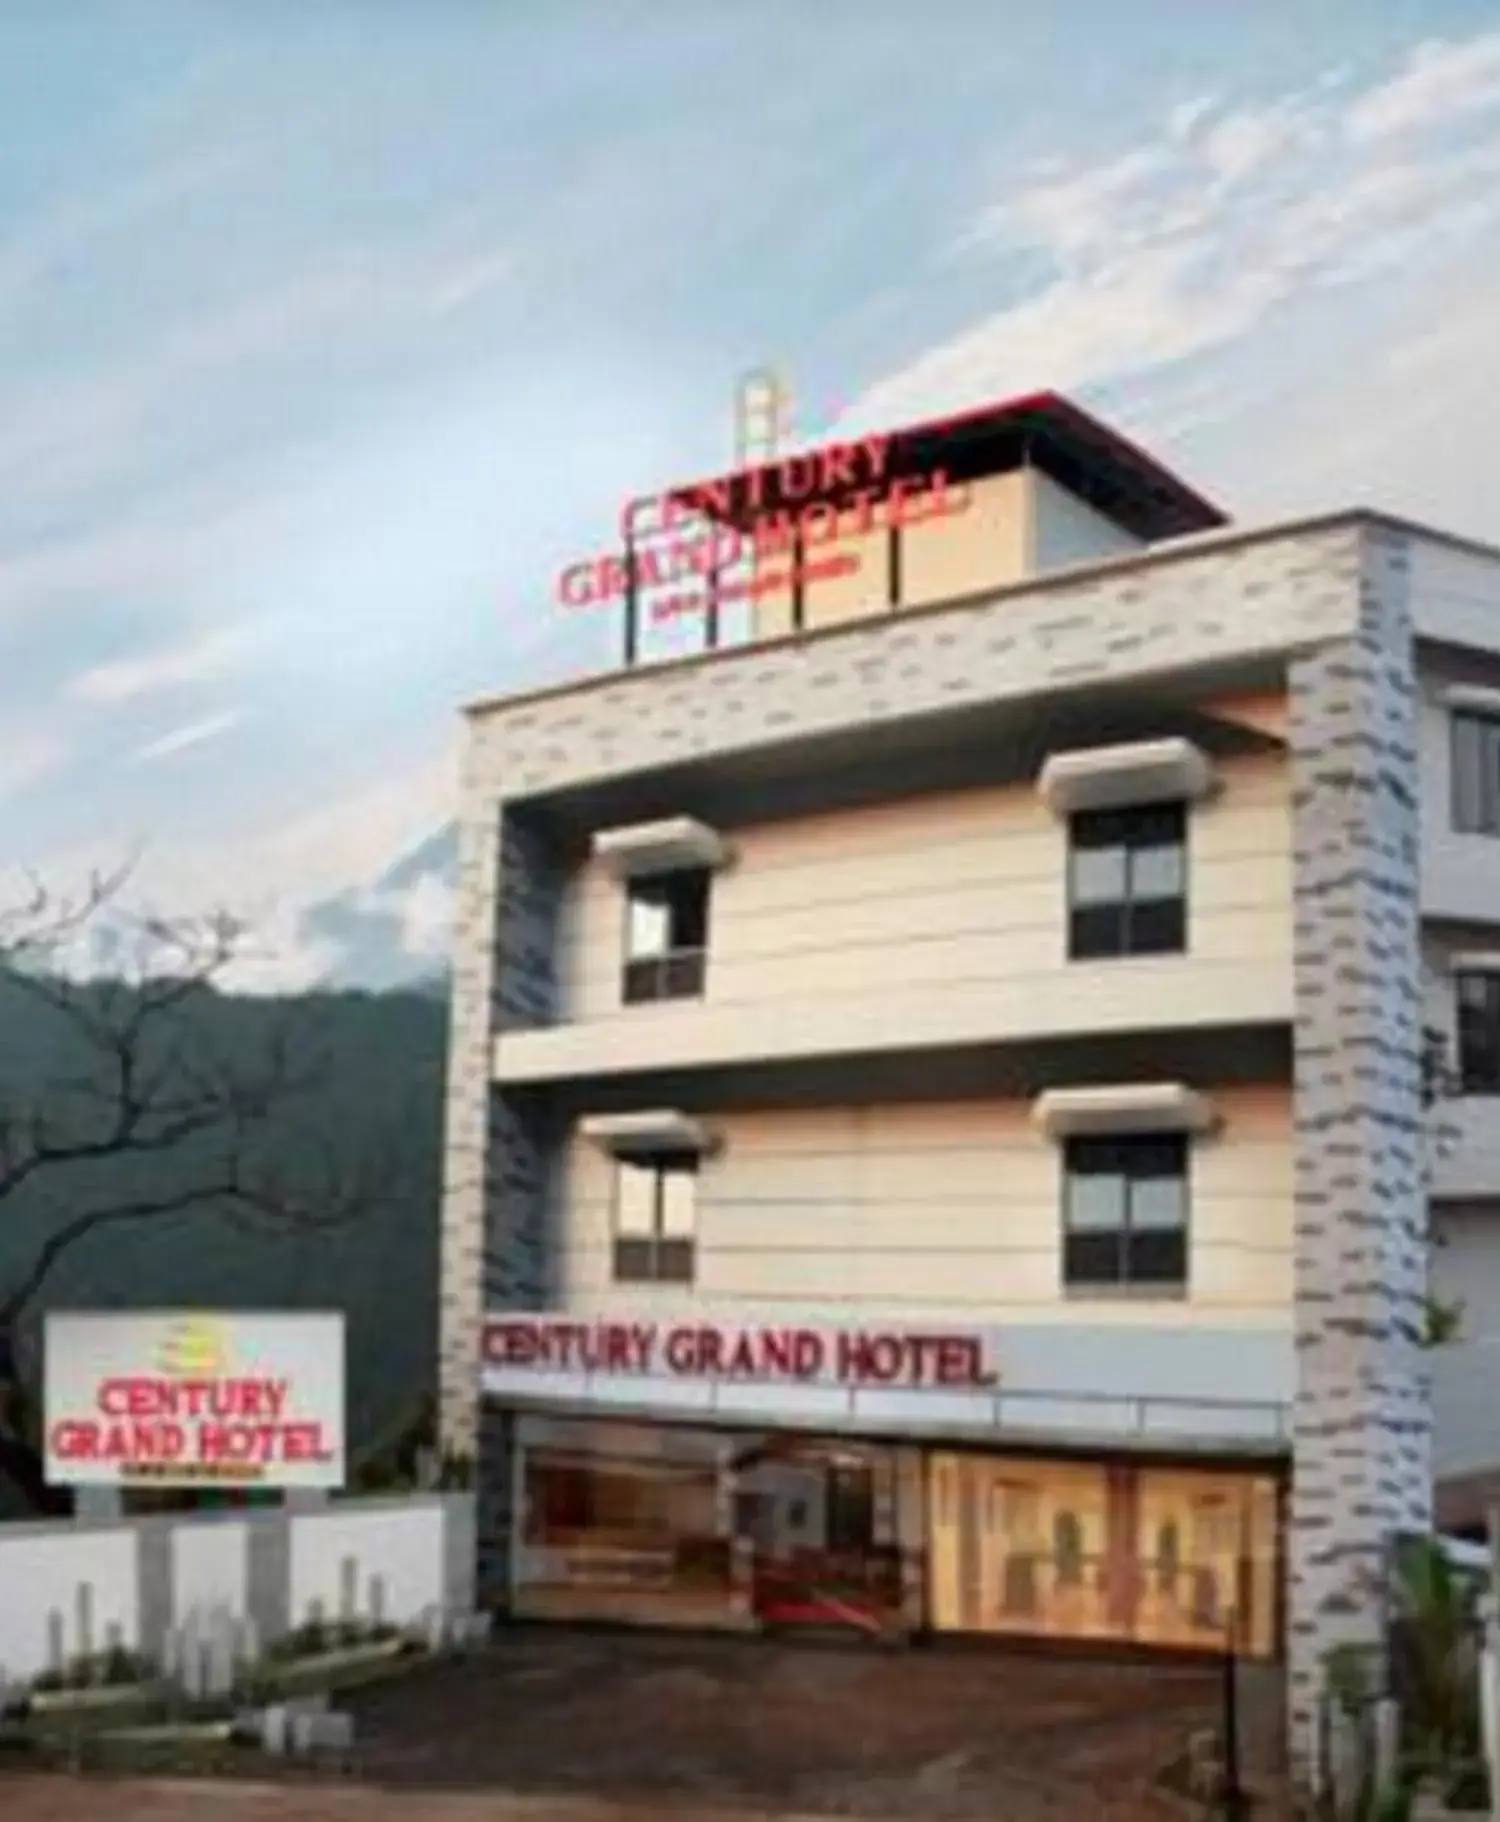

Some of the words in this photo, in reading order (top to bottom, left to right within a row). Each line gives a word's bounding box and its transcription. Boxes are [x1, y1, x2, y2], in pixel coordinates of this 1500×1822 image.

[621, 436, 893, 538] CENTURY
[558, 524, 743, 606] GRAND
[481, 1322, 656, 1373] CENTURY
[666, 1328, 824, 1380] GRAND
[837, 1331, 998, 1385] HOTEL
[98, 1377, 287, 1416] CENTURY
[52, 1420, 185, 1460] GRAND
[197, 1421, 333, 1462] HOTEL
